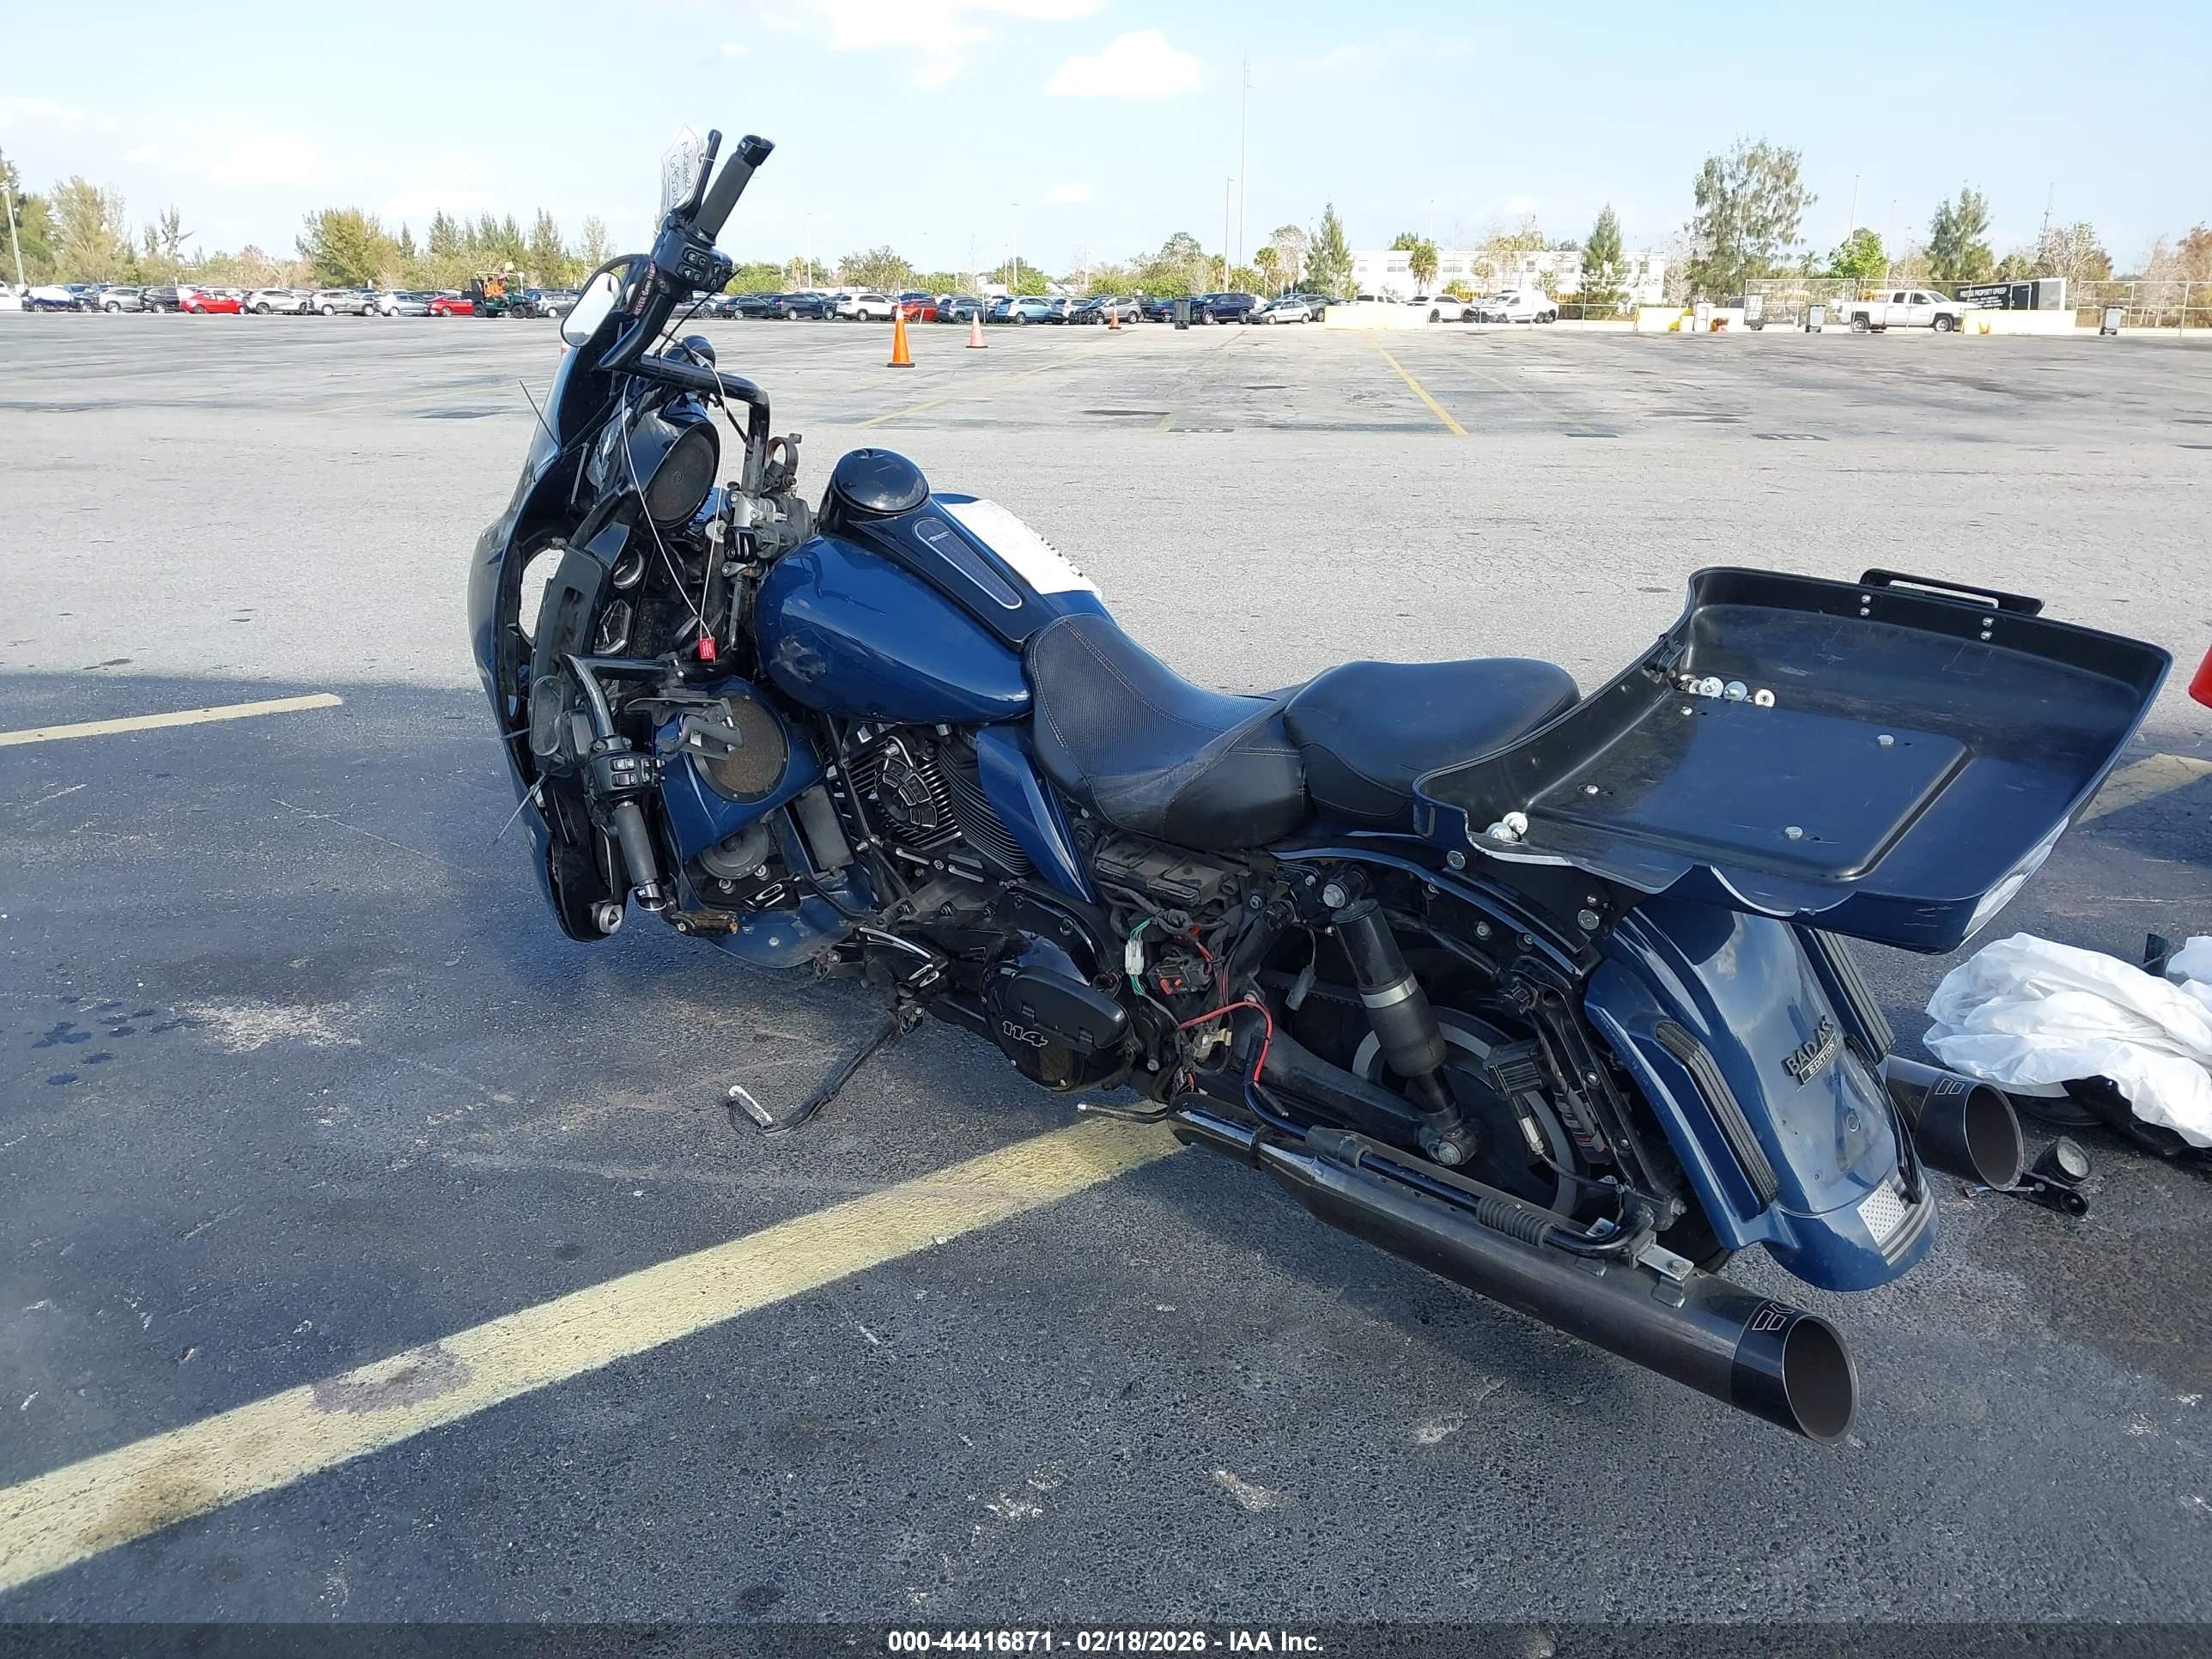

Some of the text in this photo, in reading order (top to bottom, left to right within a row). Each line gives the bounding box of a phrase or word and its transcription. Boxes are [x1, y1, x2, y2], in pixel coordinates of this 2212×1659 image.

[632, 295, 647, 316] NEVER
[1002, 1020, 1048, 1048] 114
[1785, 1042, 1819, 1075] BAD
[1808, 1040, 1835, 1075] EDITION
